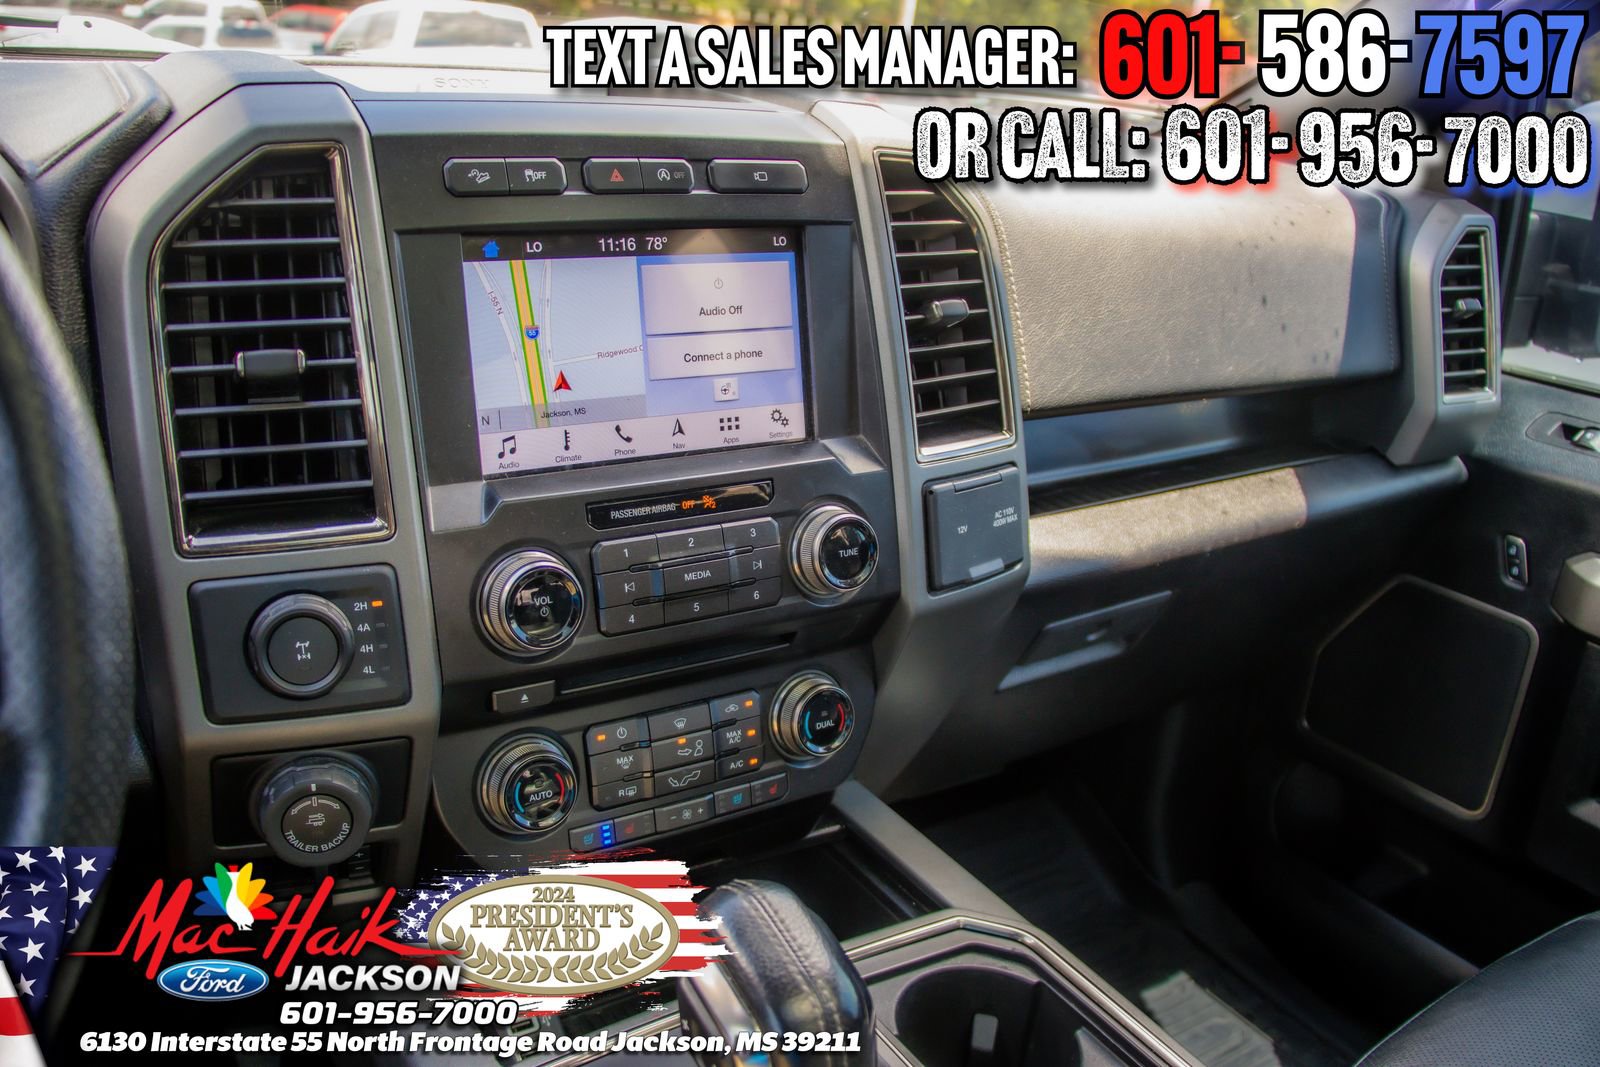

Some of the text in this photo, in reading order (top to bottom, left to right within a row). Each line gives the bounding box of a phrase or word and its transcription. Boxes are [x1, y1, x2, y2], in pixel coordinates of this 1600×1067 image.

[433, 77, 490, 88] SONY
[533, 171, 547, 180] OFF
[598, 236, 669, 252] 11:16 78°
[773, 236, 788, 247] LO
[526, 241, 543, 253] LO
[699, 305, 744, 317] Audio Off
[597, 346, 637, 360] Ridgewood
[683, 349, 764, 364] Connect a phone
[540, 407, 587, 419] Jackson, MS
[481, 415, 490, 426] N
[768, 430, 793, 440] Settings
[723, 436, 740, 445] Apps
[672, 442, 686, 450] Nav
[614, 448, 637, 457] Phone
[555, 454, 582, 464] Climate
[498, 461, 520, 470] Audio
[682, 499, 695, 510] OFF
[610, 502, 676, 520] PASSENGER AIRBAG
[994, 510, 1003, 519] AC
[1007, 513, 1018, 523] MAX
[750, 527, 757, 538] 3
[957, 525, 968, 534] 12V
[688, 537, 695, 547] 2
[623, 548, 629, 558] 1
[838, 547, 860, 558] TUNE
[684, 569, 712, 582] MEDIA
[753, 590, 760, 600] 6
[534, 596, 553, 606] VOL
[354, 602, 368, 611] 2H
[693, 602, 700, 612] 5
[628, 614, 636, 624] 4
[357, 623, 371, 632] 4A
[359, 643, 374, 653] 4H
[362, 664, 376, 674] 4L
[816, 720, 835, 730] DUAL
[726, 728, 742, 738] MAX
[728, 735, 742, 744] A/C
[616, 755, 634, 765] MAX
[729, 760, 744, 770] A/C
[529, 790, 553, 802] AUTO
[285, 822, 351, 853] TRAILER BACKUP
